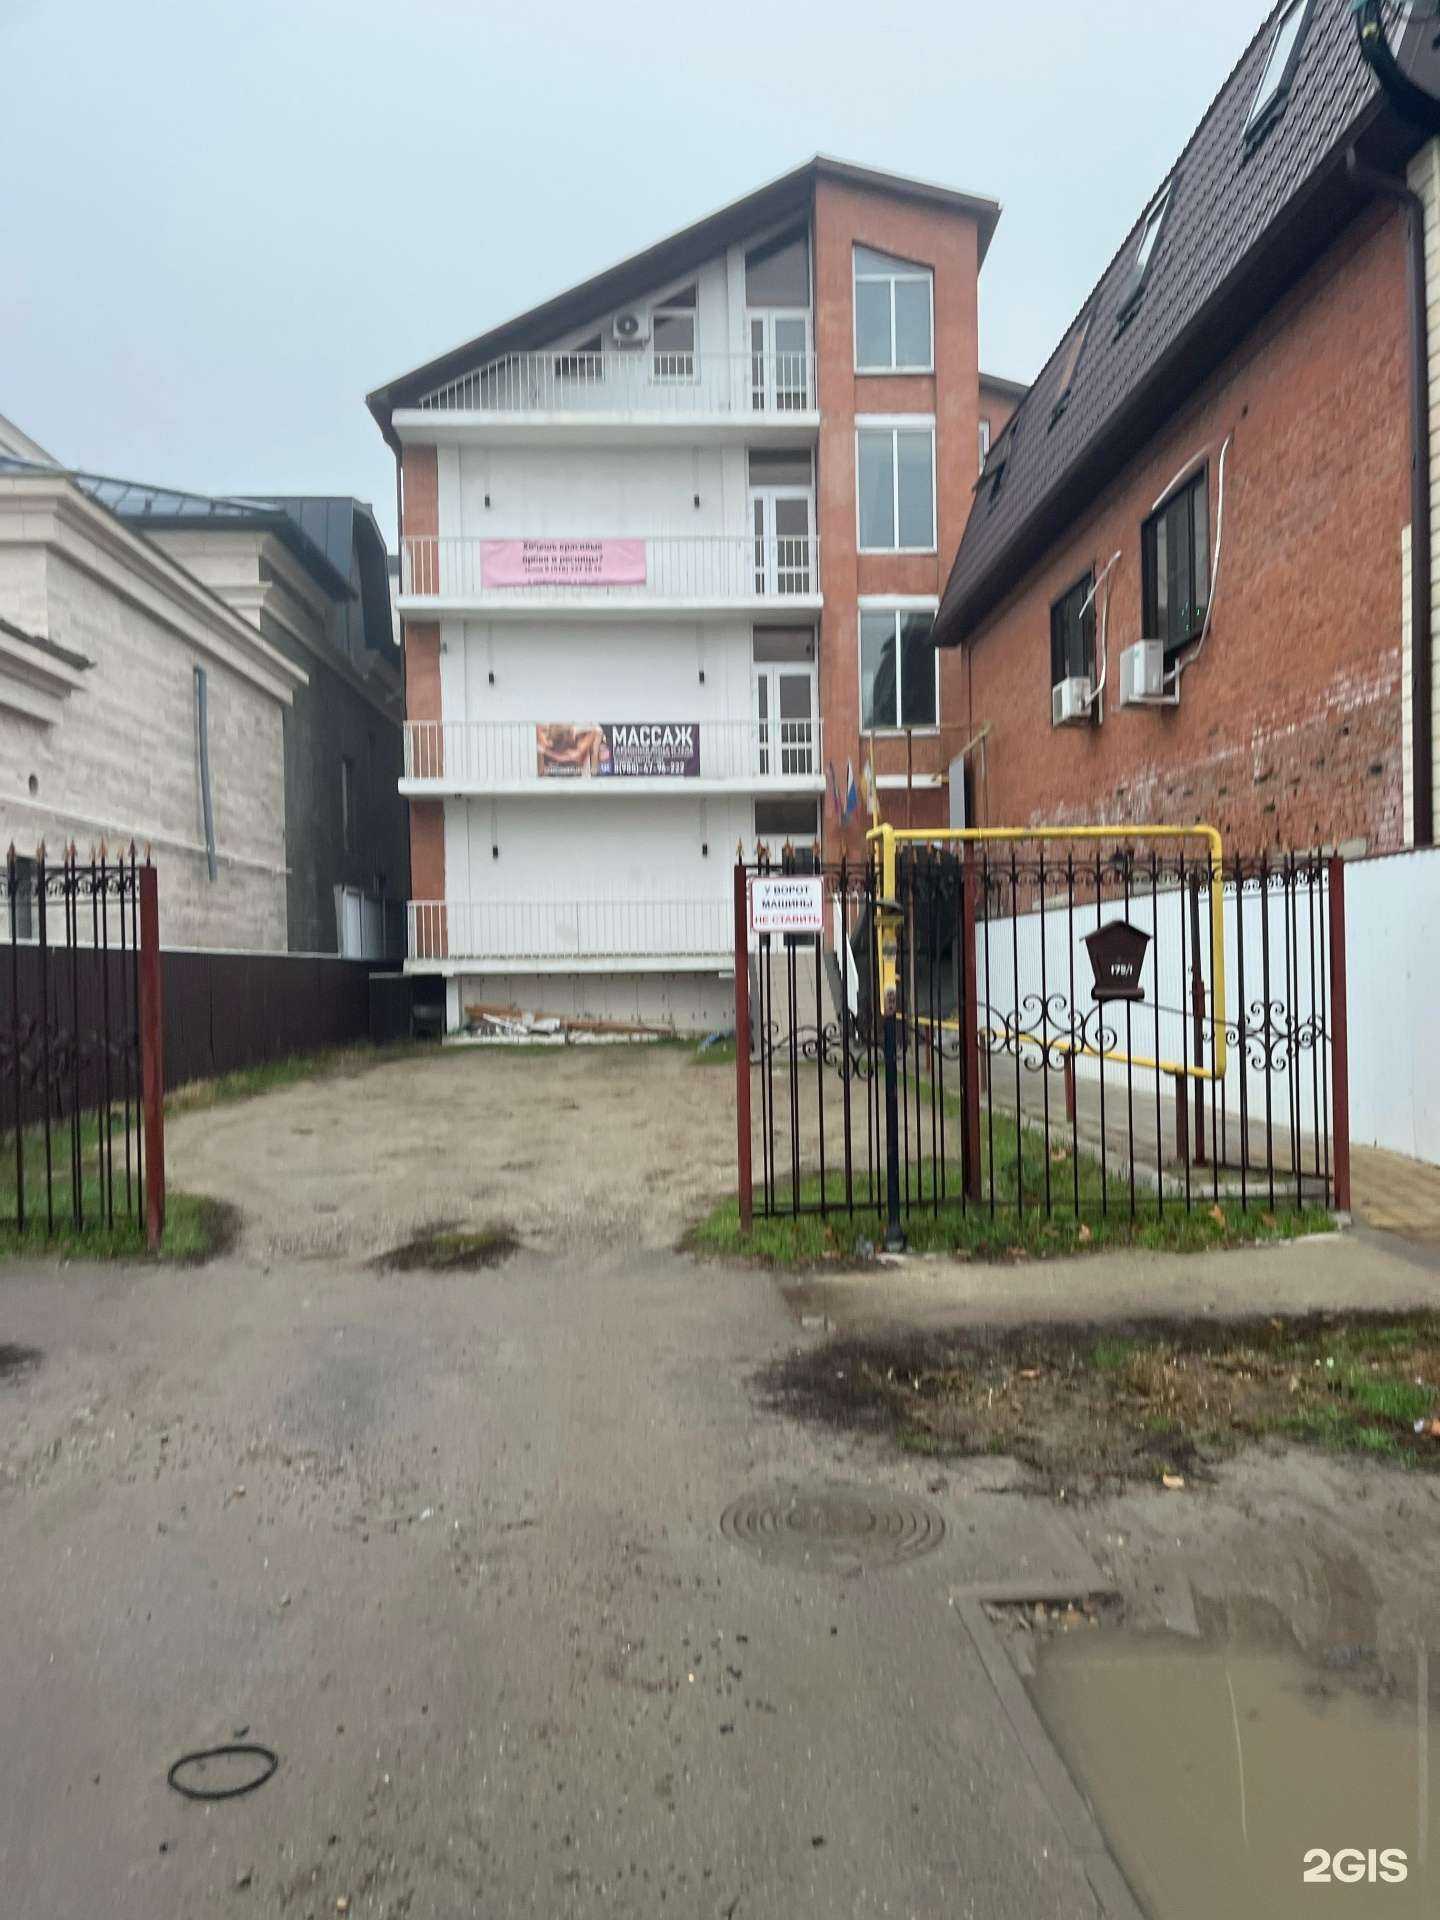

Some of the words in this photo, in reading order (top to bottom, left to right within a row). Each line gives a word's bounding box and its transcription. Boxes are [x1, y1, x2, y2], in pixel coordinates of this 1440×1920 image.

[612, 725, 694, 747] МАССАЖ
[764, 885, 771, 894] У
[773, 885, 808, 894] ВОРОТ
[762, 900, 813, 909] МАШИНЫ
[755, 915, 769, 924] НЕ
[772, 915, 820, 924] СТАВИТЬ
